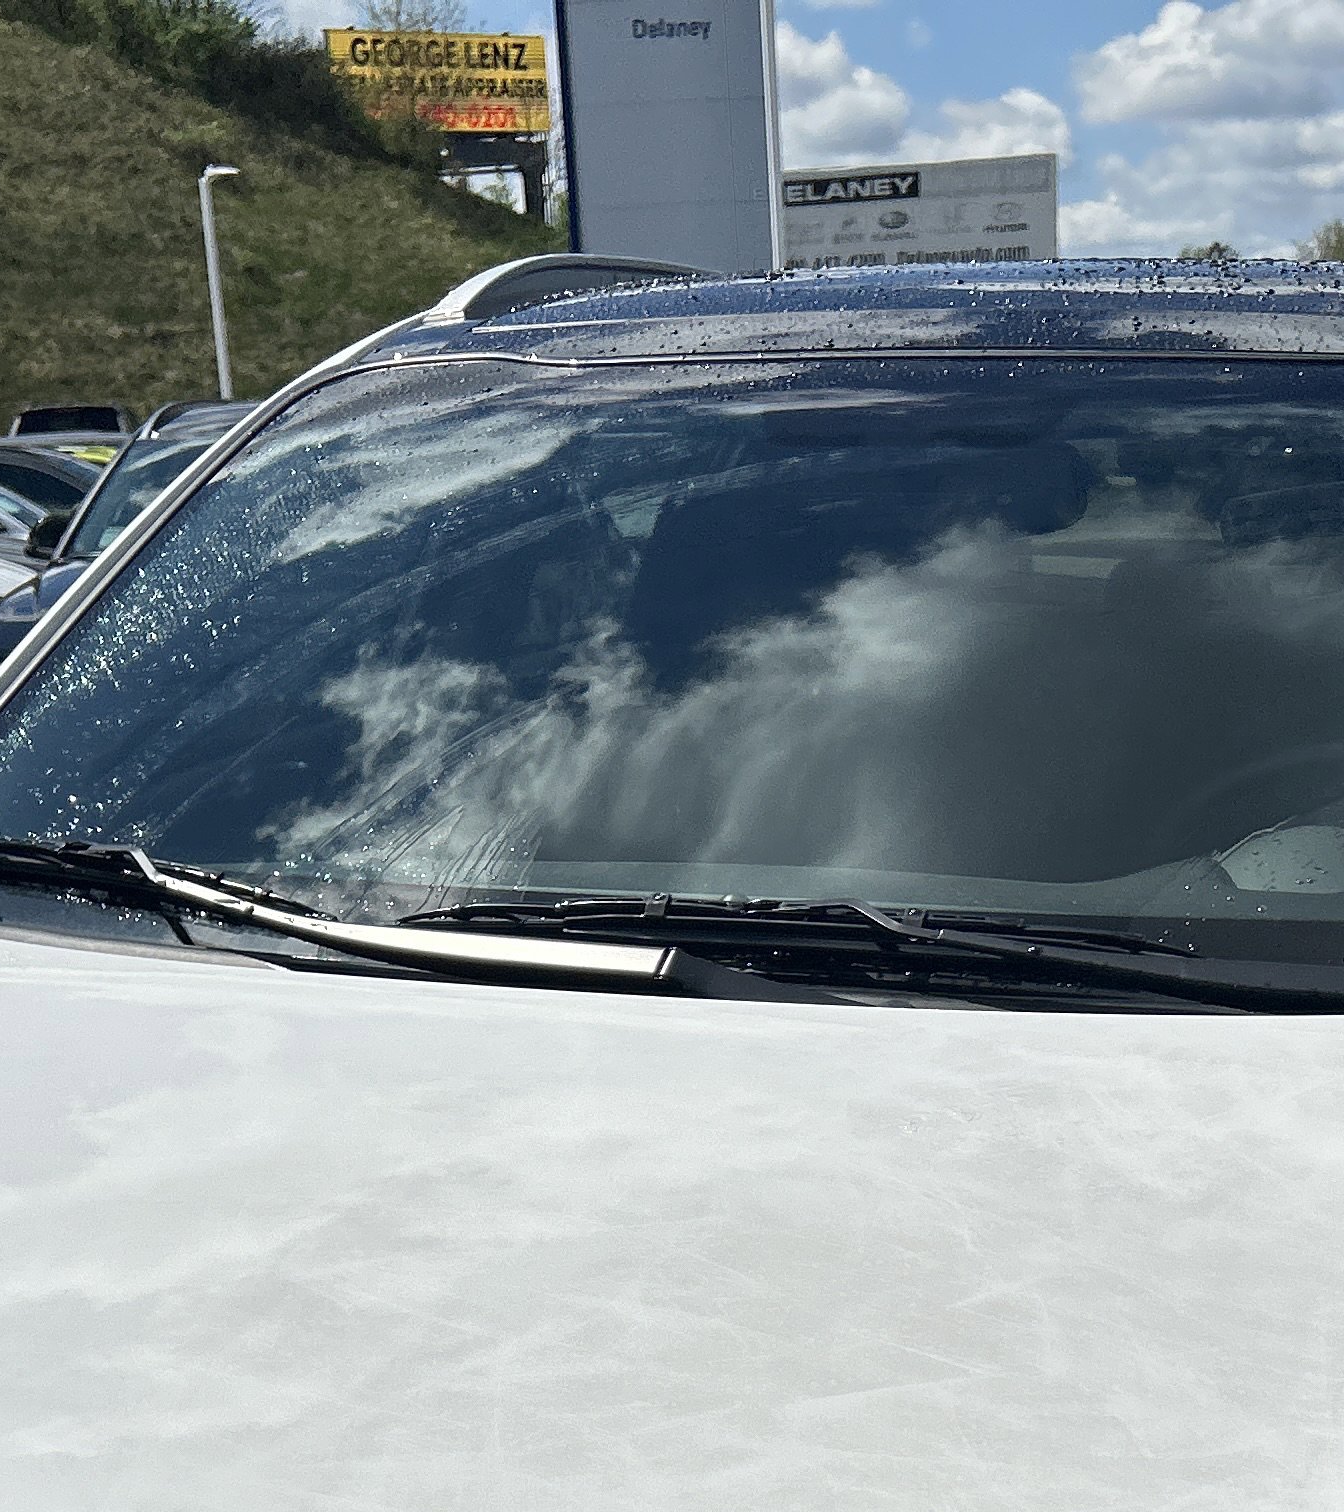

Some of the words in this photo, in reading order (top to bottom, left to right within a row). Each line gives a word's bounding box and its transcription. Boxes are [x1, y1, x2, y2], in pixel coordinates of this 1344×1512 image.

[631, 18, 712, 40] Delaney
[350, 37, 456, 68] GEORGE
[463, 41, 528, 71] LENZ
[785, 175, 915, 203] ELANEY
